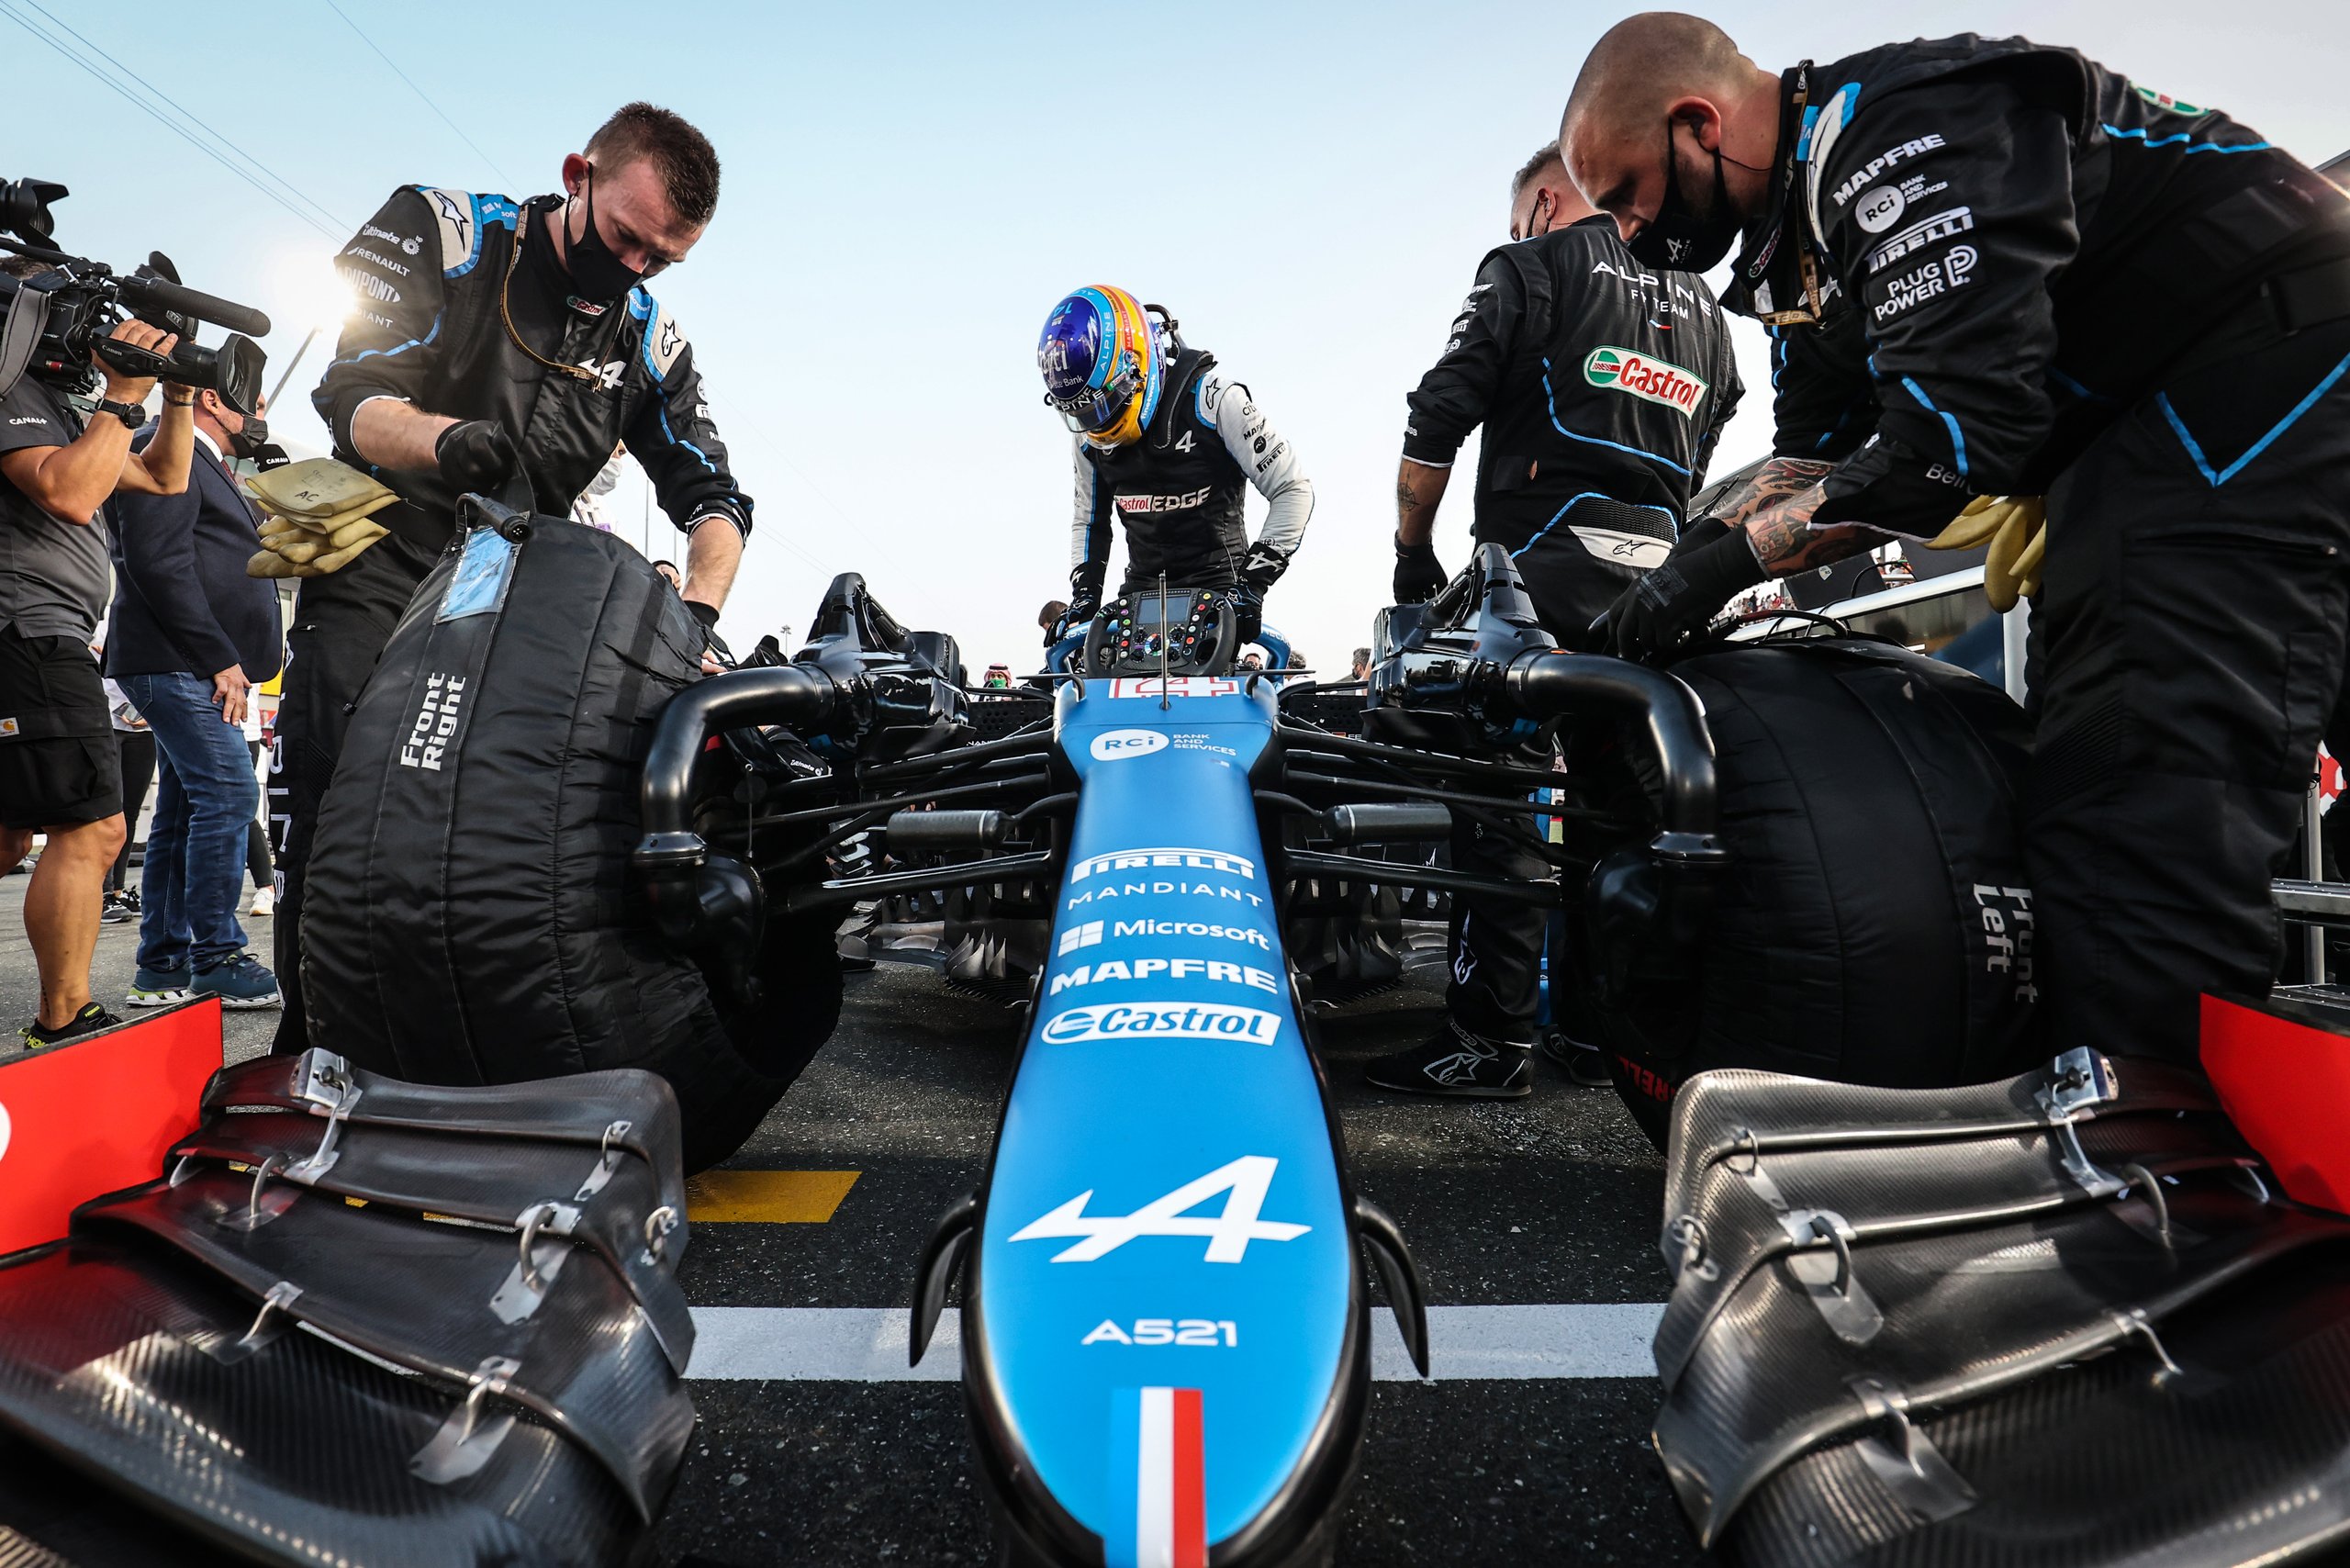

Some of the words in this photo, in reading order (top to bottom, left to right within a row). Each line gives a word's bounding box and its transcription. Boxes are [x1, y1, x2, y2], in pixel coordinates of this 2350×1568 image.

[1832, 133, 1946, 206] MAPFRE
[1899, 174, 1926, 191] BANK
[1904, 183, 1925, 196] AND
[1906, 181, 1948, 205] SERVICES
[1864, 206, 1974, 274] PIRELLI
[356, 248, 410, 276] RENAULT
[344, 265, 397, 303] DUPONT
[1592, 261, 1711, 318] ALPINE
[1887, 262, 1941, 297] PLUG
[1653, 297, 1689, 319] TEAM
[1874, 277, 1945, 321] POWER
[102, 344, 123, 356] Canon
[1101, 311, 1111, 372] ALPINE
[1619, 357, 1701, 412] Castrol
[9, 416, 48, 426] CANAL+
[295, 490, 319, 502] AC
[1151, 486, 1211, 512] EDGE
[400, 672, 446, 768] Front
[421, 676, 466, 771] Right
[1173, 744, 1237, 756] SERVICES
[1071, 846, 1255, 884] PIRELLI
[1068, 881, 1263, 911] MANDIANT
[1113, 918, 1270, 951] Microsoft
[1972, 882, 2015, 974] Left
[2002, 885, 2040, 1004] Front
[1049, 958, 1279, 996] MAPFRE
[1099, 1007, 1263, 1037] Castrol
[1080, 1318, 1238, 1348] A521
